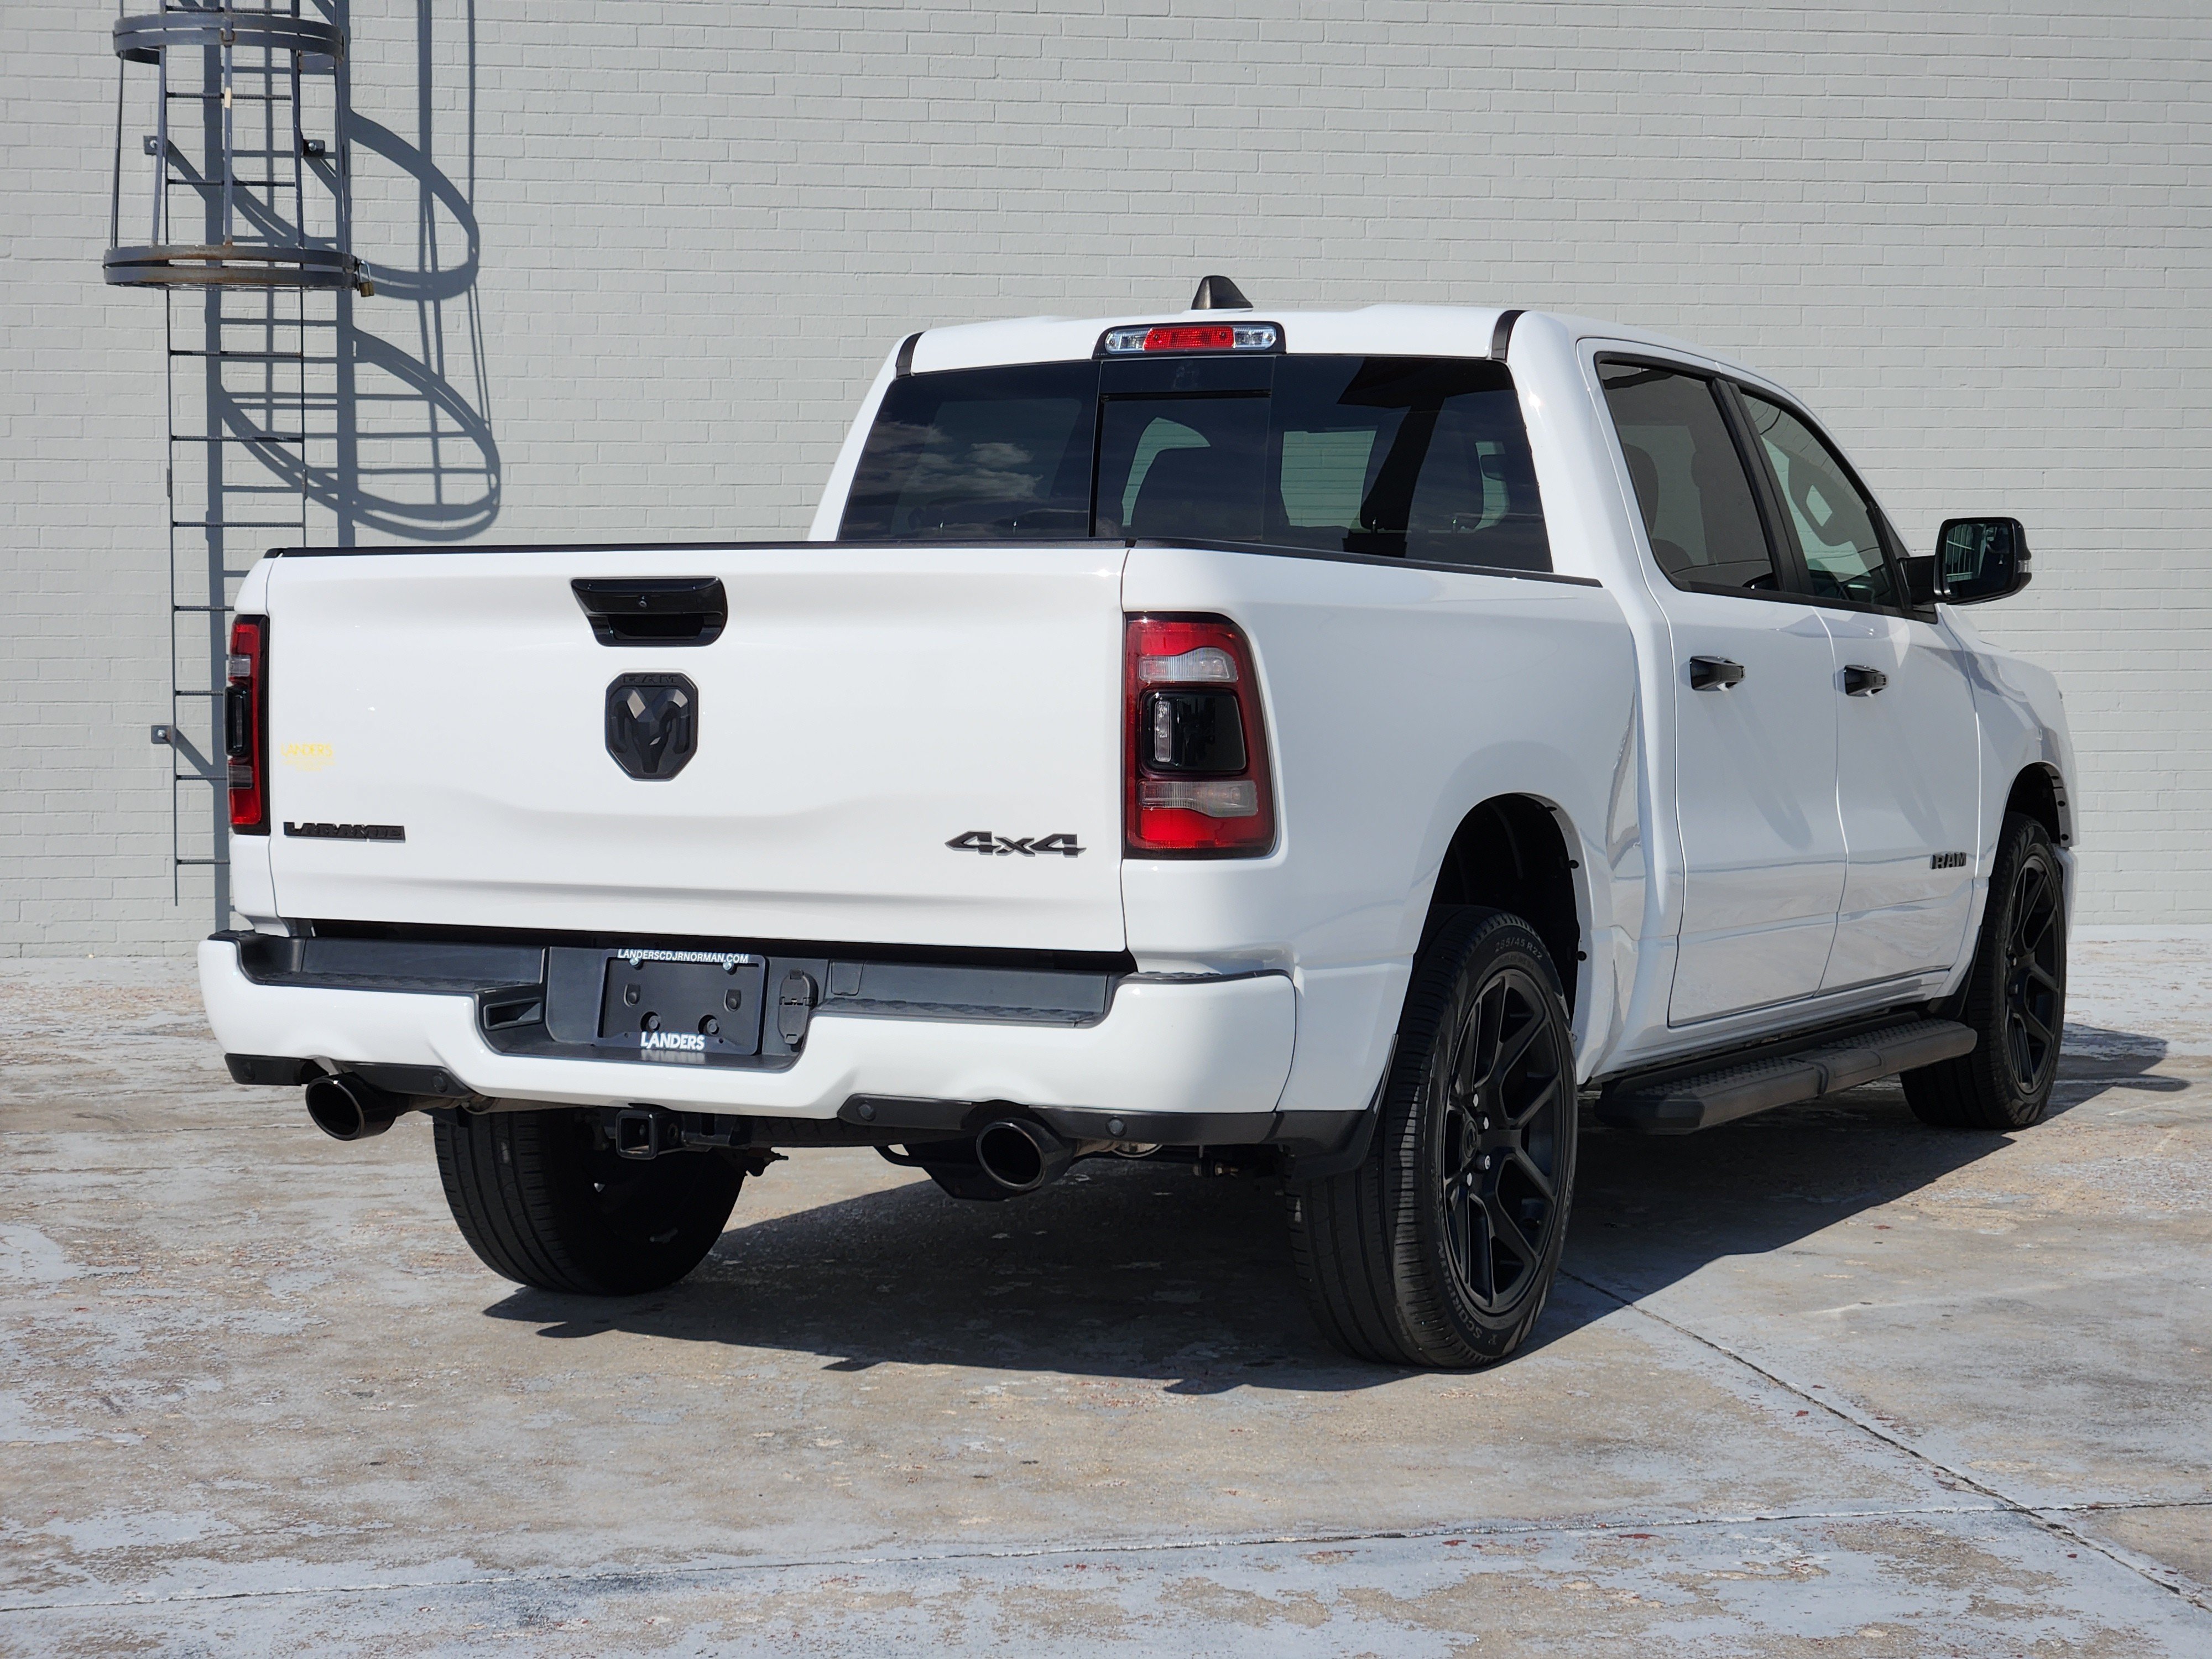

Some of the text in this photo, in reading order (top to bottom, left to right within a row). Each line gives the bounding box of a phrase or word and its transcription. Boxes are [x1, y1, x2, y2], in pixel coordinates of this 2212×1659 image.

[623, 675, 677, 684] RAM
[280, 743, 333, 757] LANDERS
[283, 822, 405, 843] LARAMIE
[945, 830, 1087, 858] 4x4
[1930, 852, 1966, 869] RAM
[617, 948, 748, 963] LANDERSCDJRNORMAN.COM
[640, 1031, 705, 1051] LANDERS
